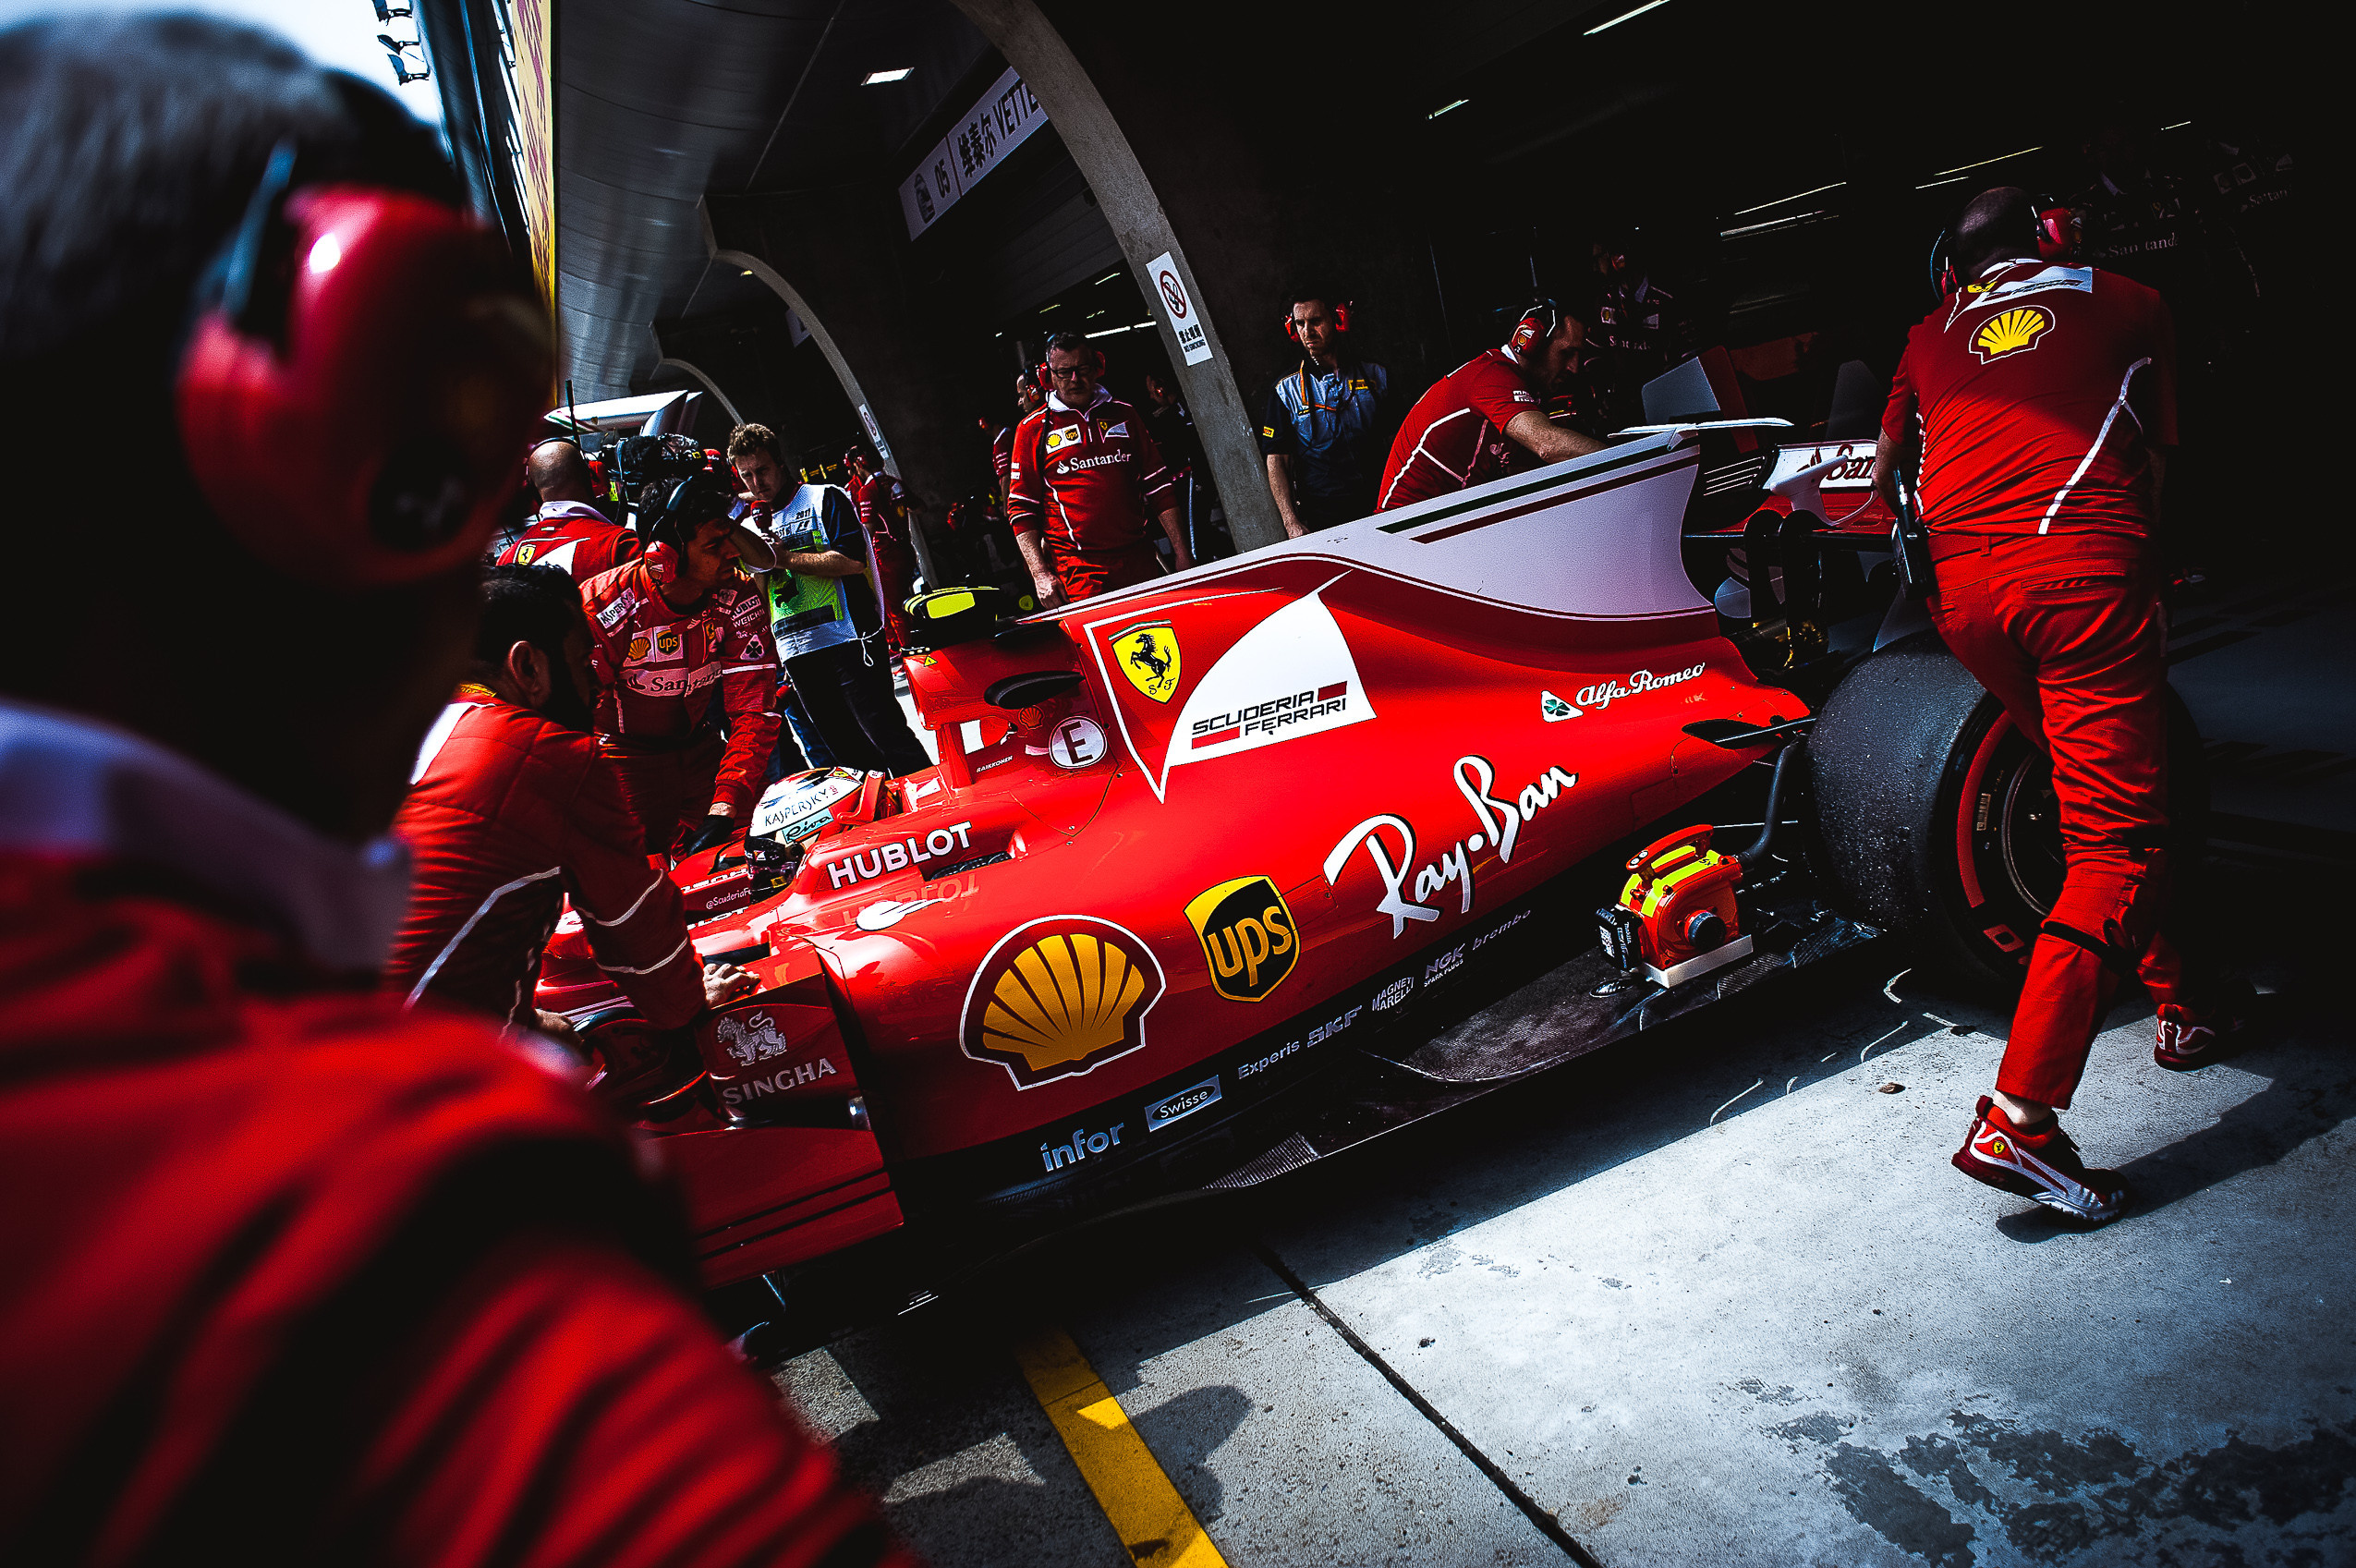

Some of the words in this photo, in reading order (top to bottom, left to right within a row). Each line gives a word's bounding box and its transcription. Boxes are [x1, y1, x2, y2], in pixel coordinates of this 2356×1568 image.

[934, 158, 951, 199] 05
[1070, 449, 1132, 472] Santander
[658, 635, 679, 652] ups
[1575, 679, 1632, 711] Alfa
[1629, 662, 1706, 694] Romeo
[1192, 690, 1315, 735] SCUDERIA
[1245, 698, 1347, 736] FERRARI
[976, 755, 1014, 773] RAIKKONEN
[1060, 721, 1093, 765] E
[826, 820, 972, 890] HUBLOT
[1207, 906, 1293, 988] ups
[1472, 909, 1532, 952] brembo
[1424, 942, 1465, 979] NGK
[1306, 1004, 1363, 1048] SKF
[723, 1057, 838, 1105] SINGHA
[1237, 1039, 1301, 1080] Experis
[1160, 1089, 1208, 1119] Swisse
[1040, 1122, 1125, 1173] infor
